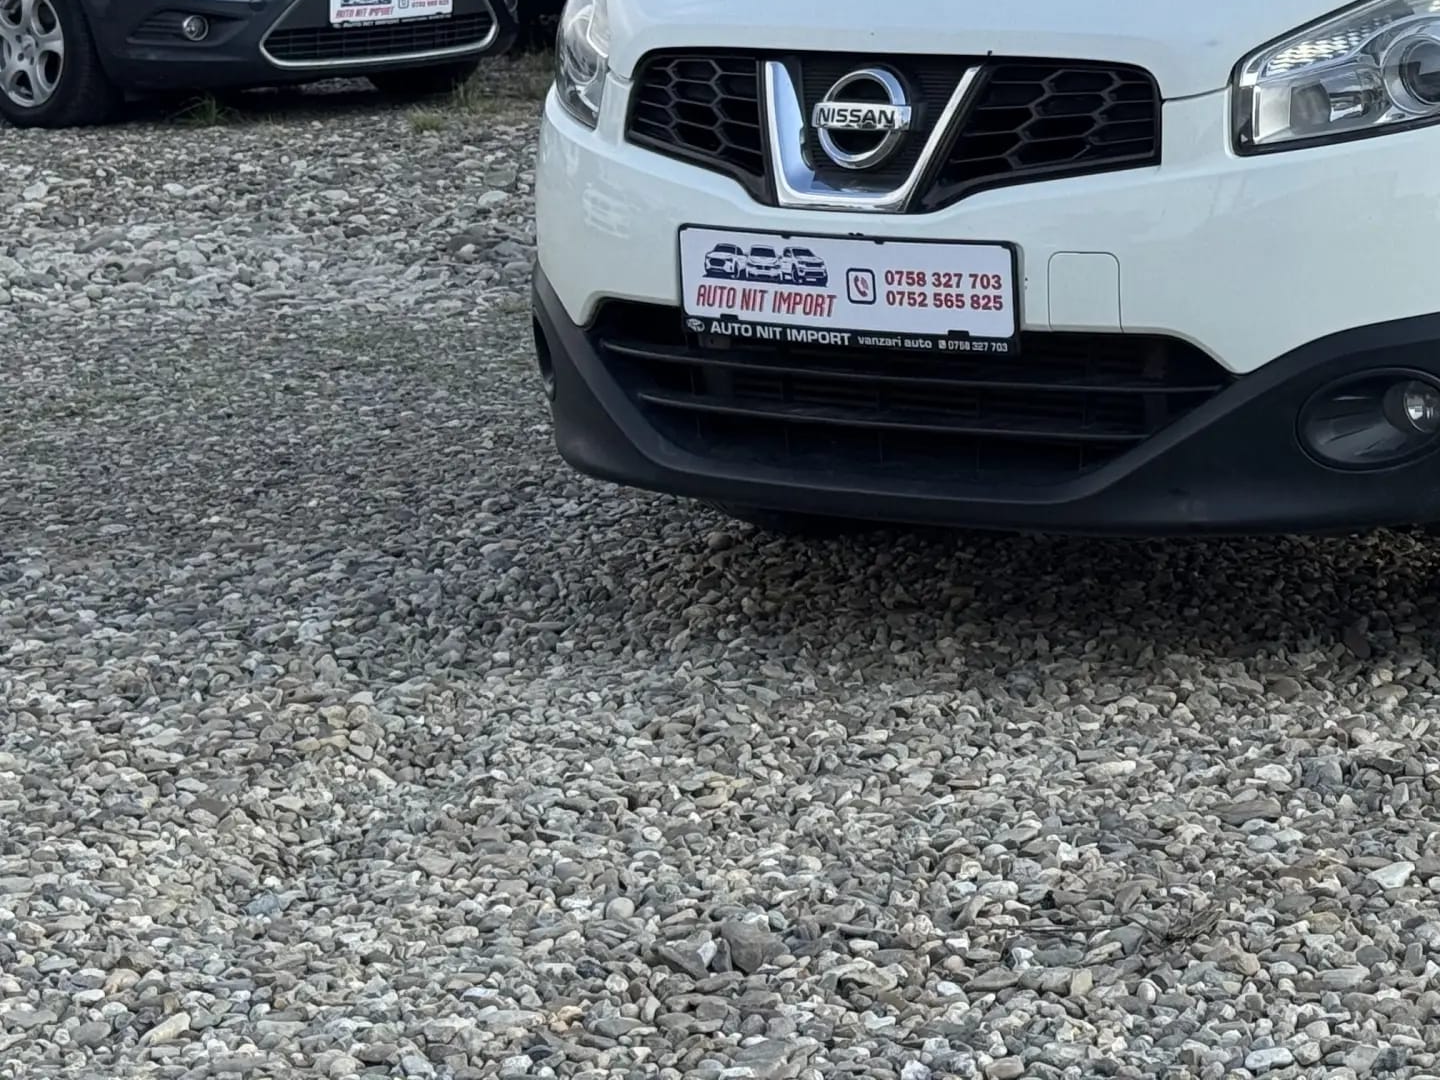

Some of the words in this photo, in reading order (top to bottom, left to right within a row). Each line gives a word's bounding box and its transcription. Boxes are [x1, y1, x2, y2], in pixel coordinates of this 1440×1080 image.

[819, 108, 895, 124] NISSAN
[885, 270, 926, 287] 0758
[931, 272, 963, 288] 327
[969, 273, 1002, 290] 703
[696, 284, 736, 308] AUTO
[740, 288, 768, 312] NIT
[772, 290, 836, 317] IMPORT
[886, 290, 928, 307] 0752
[933, 292, 965, 309] 565
[970, 294, 1003, 310] 825
[710, 321, 752, 337] AUTO
[752, 326, 782, 340] NIT
[787, 328, 851, 346] IMPORT
[904, 338, 932, 349] auto
